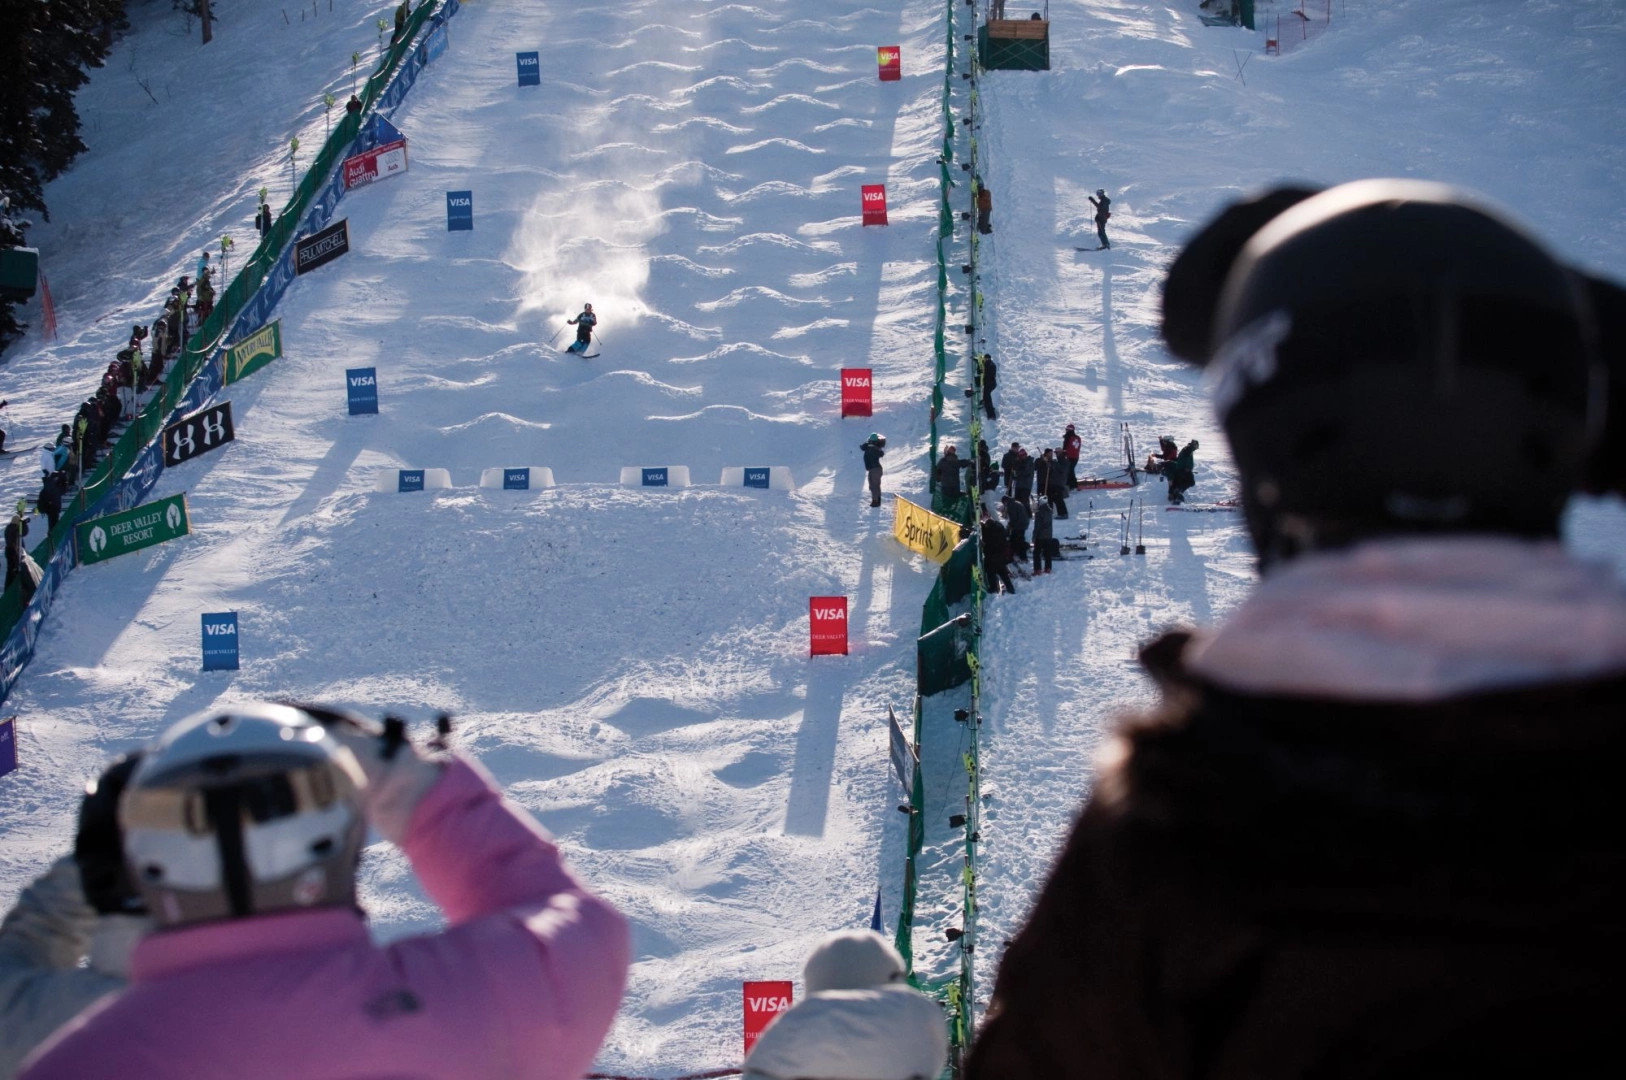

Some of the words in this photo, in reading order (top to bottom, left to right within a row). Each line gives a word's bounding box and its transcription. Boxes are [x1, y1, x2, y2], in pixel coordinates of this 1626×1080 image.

[880, 52, 899, 60] VISA
[519, 58, 538, 66] VISA
[349, 163, 365, 179] Audi
[349, 170, 376, 188] quattro
[864, 192, 884, 201] VISA
[449, 198, 471, 207] VISA
[350, 376, 375, 387] VISA
[844, 377, 870, 387] VISA
[404, 475, 421, 483] VISA
[508, 474, 525, 482] VISA
[647, 473, 664, 481] VISA
[110, 521, 133, 536] DEER
[133, 511, 162, 527] VALLEY
[123, 527, 154, 546] RESORT
[905, 516, 934, 550] Sprint
[813, 608, 845, 620] VISA
[205, 623, 236, 636] VISA
[747, 996, 790, 1012] VISA
